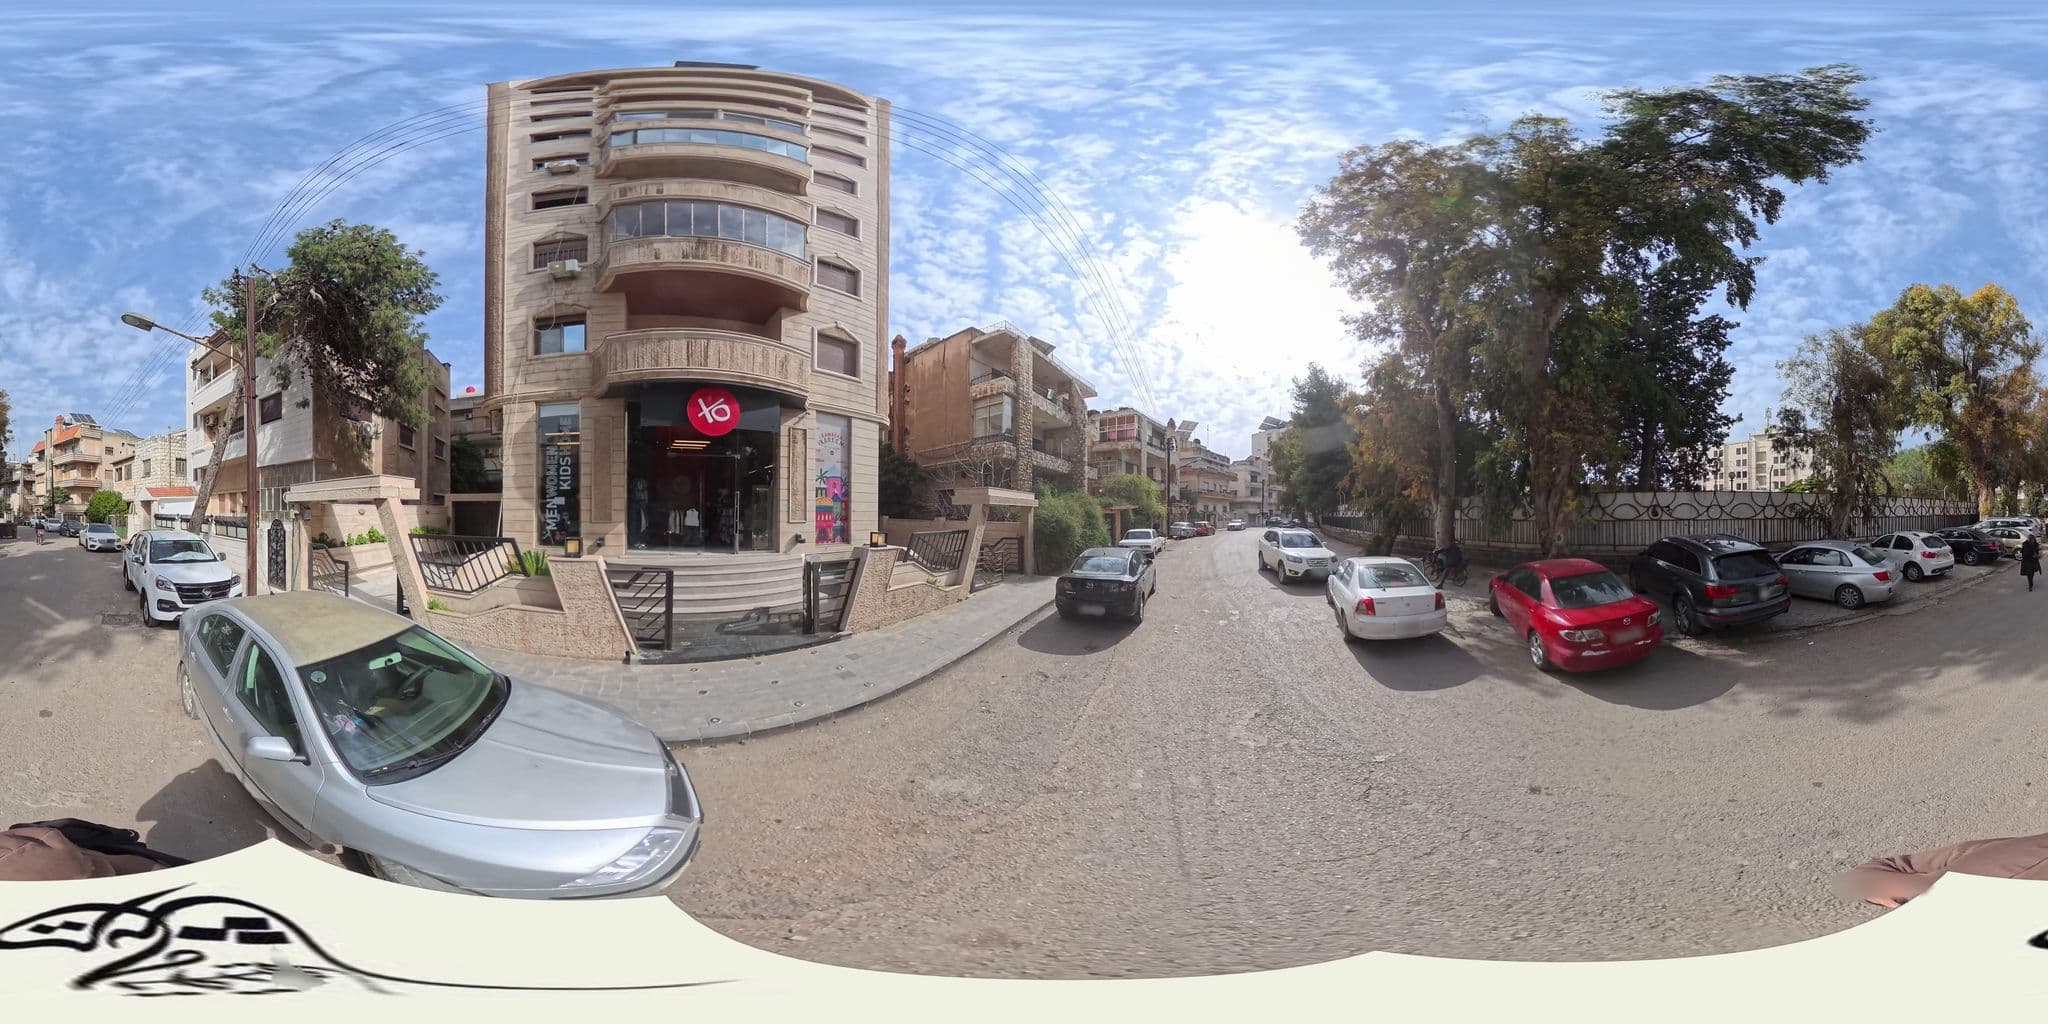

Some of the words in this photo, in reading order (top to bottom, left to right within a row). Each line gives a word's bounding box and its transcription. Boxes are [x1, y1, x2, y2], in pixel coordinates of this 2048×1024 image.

[698, 398, 731, 424] XO
[546, 446, 558, 497] WOMEN
[559, 456, 571, 490] KIDS
[546, 498, 558, 530] MEN
